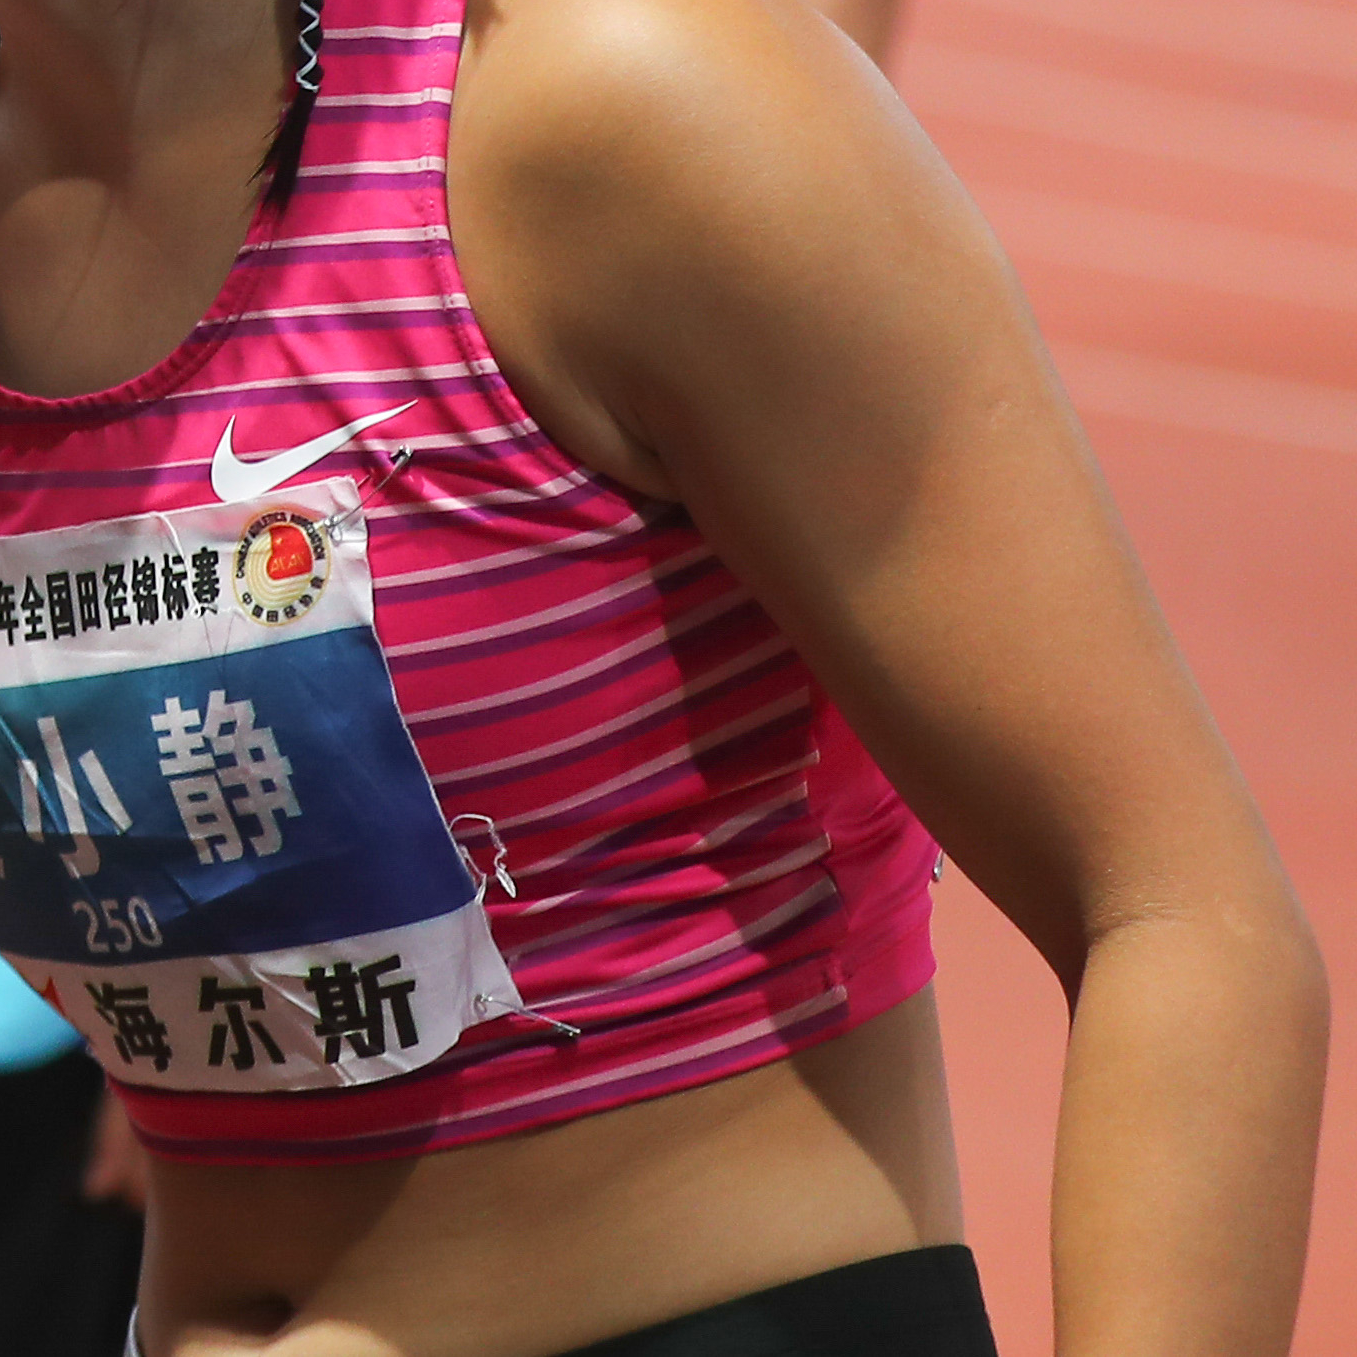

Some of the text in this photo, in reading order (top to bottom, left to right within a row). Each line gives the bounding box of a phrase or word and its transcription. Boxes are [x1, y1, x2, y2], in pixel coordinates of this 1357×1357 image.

[72, 897, 164, 953] 250
[84, 954, 419, 1072] 海尔斯
